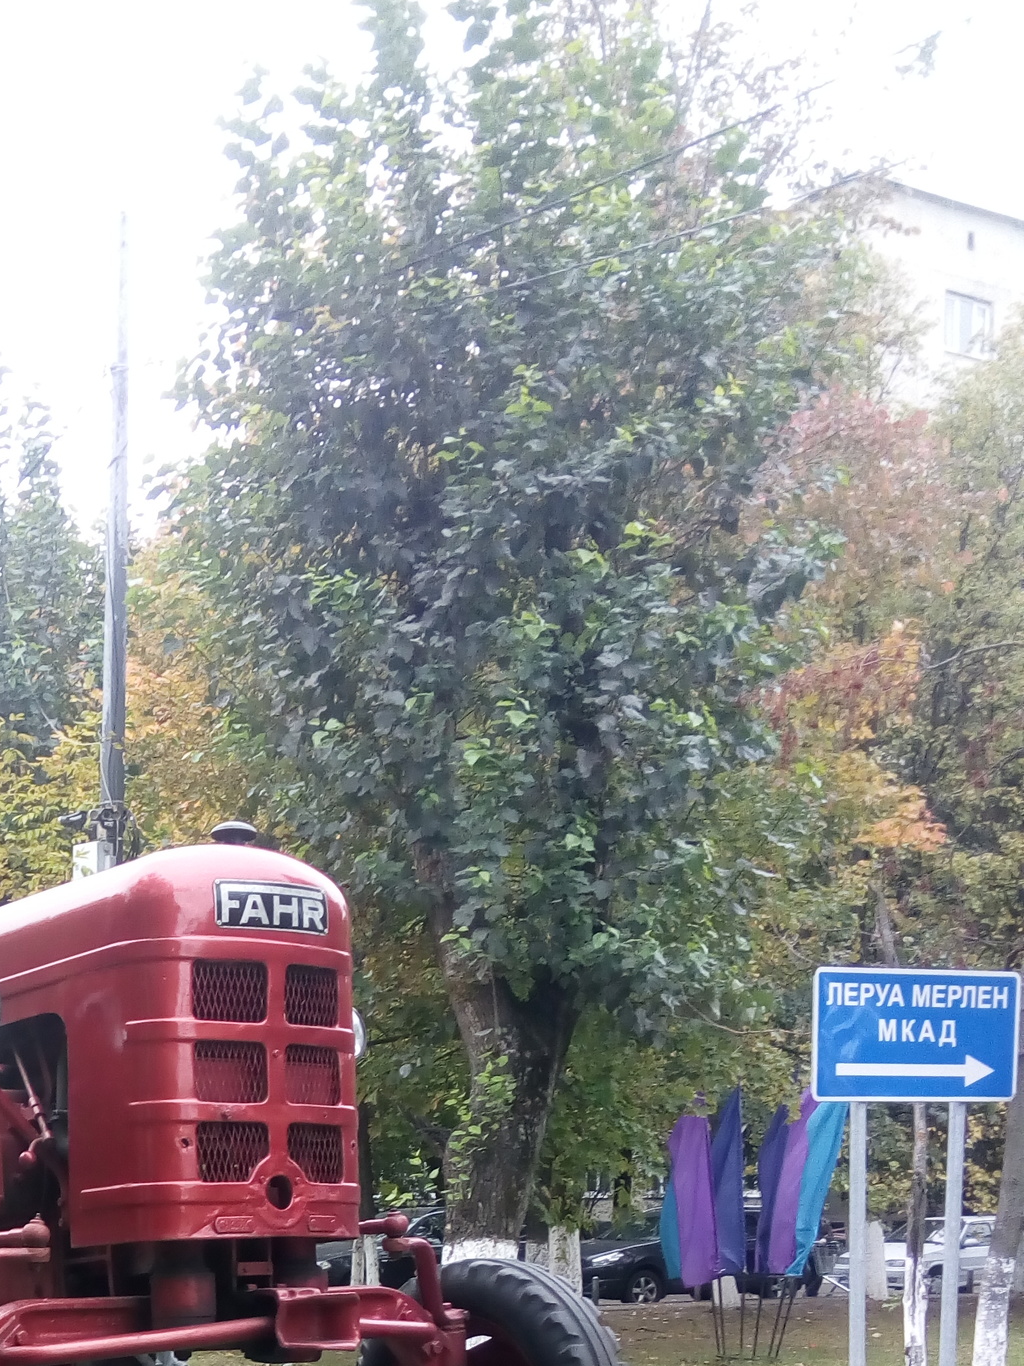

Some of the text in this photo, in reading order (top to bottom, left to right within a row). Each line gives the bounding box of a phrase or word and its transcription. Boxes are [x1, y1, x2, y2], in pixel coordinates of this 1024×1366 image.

[220, 883, 325, 930] FAHR
[826, 982, 1008, 1008] ЛЕРУА МЕРЛЕН
[878, 1018, 957, 1047] МКАД
